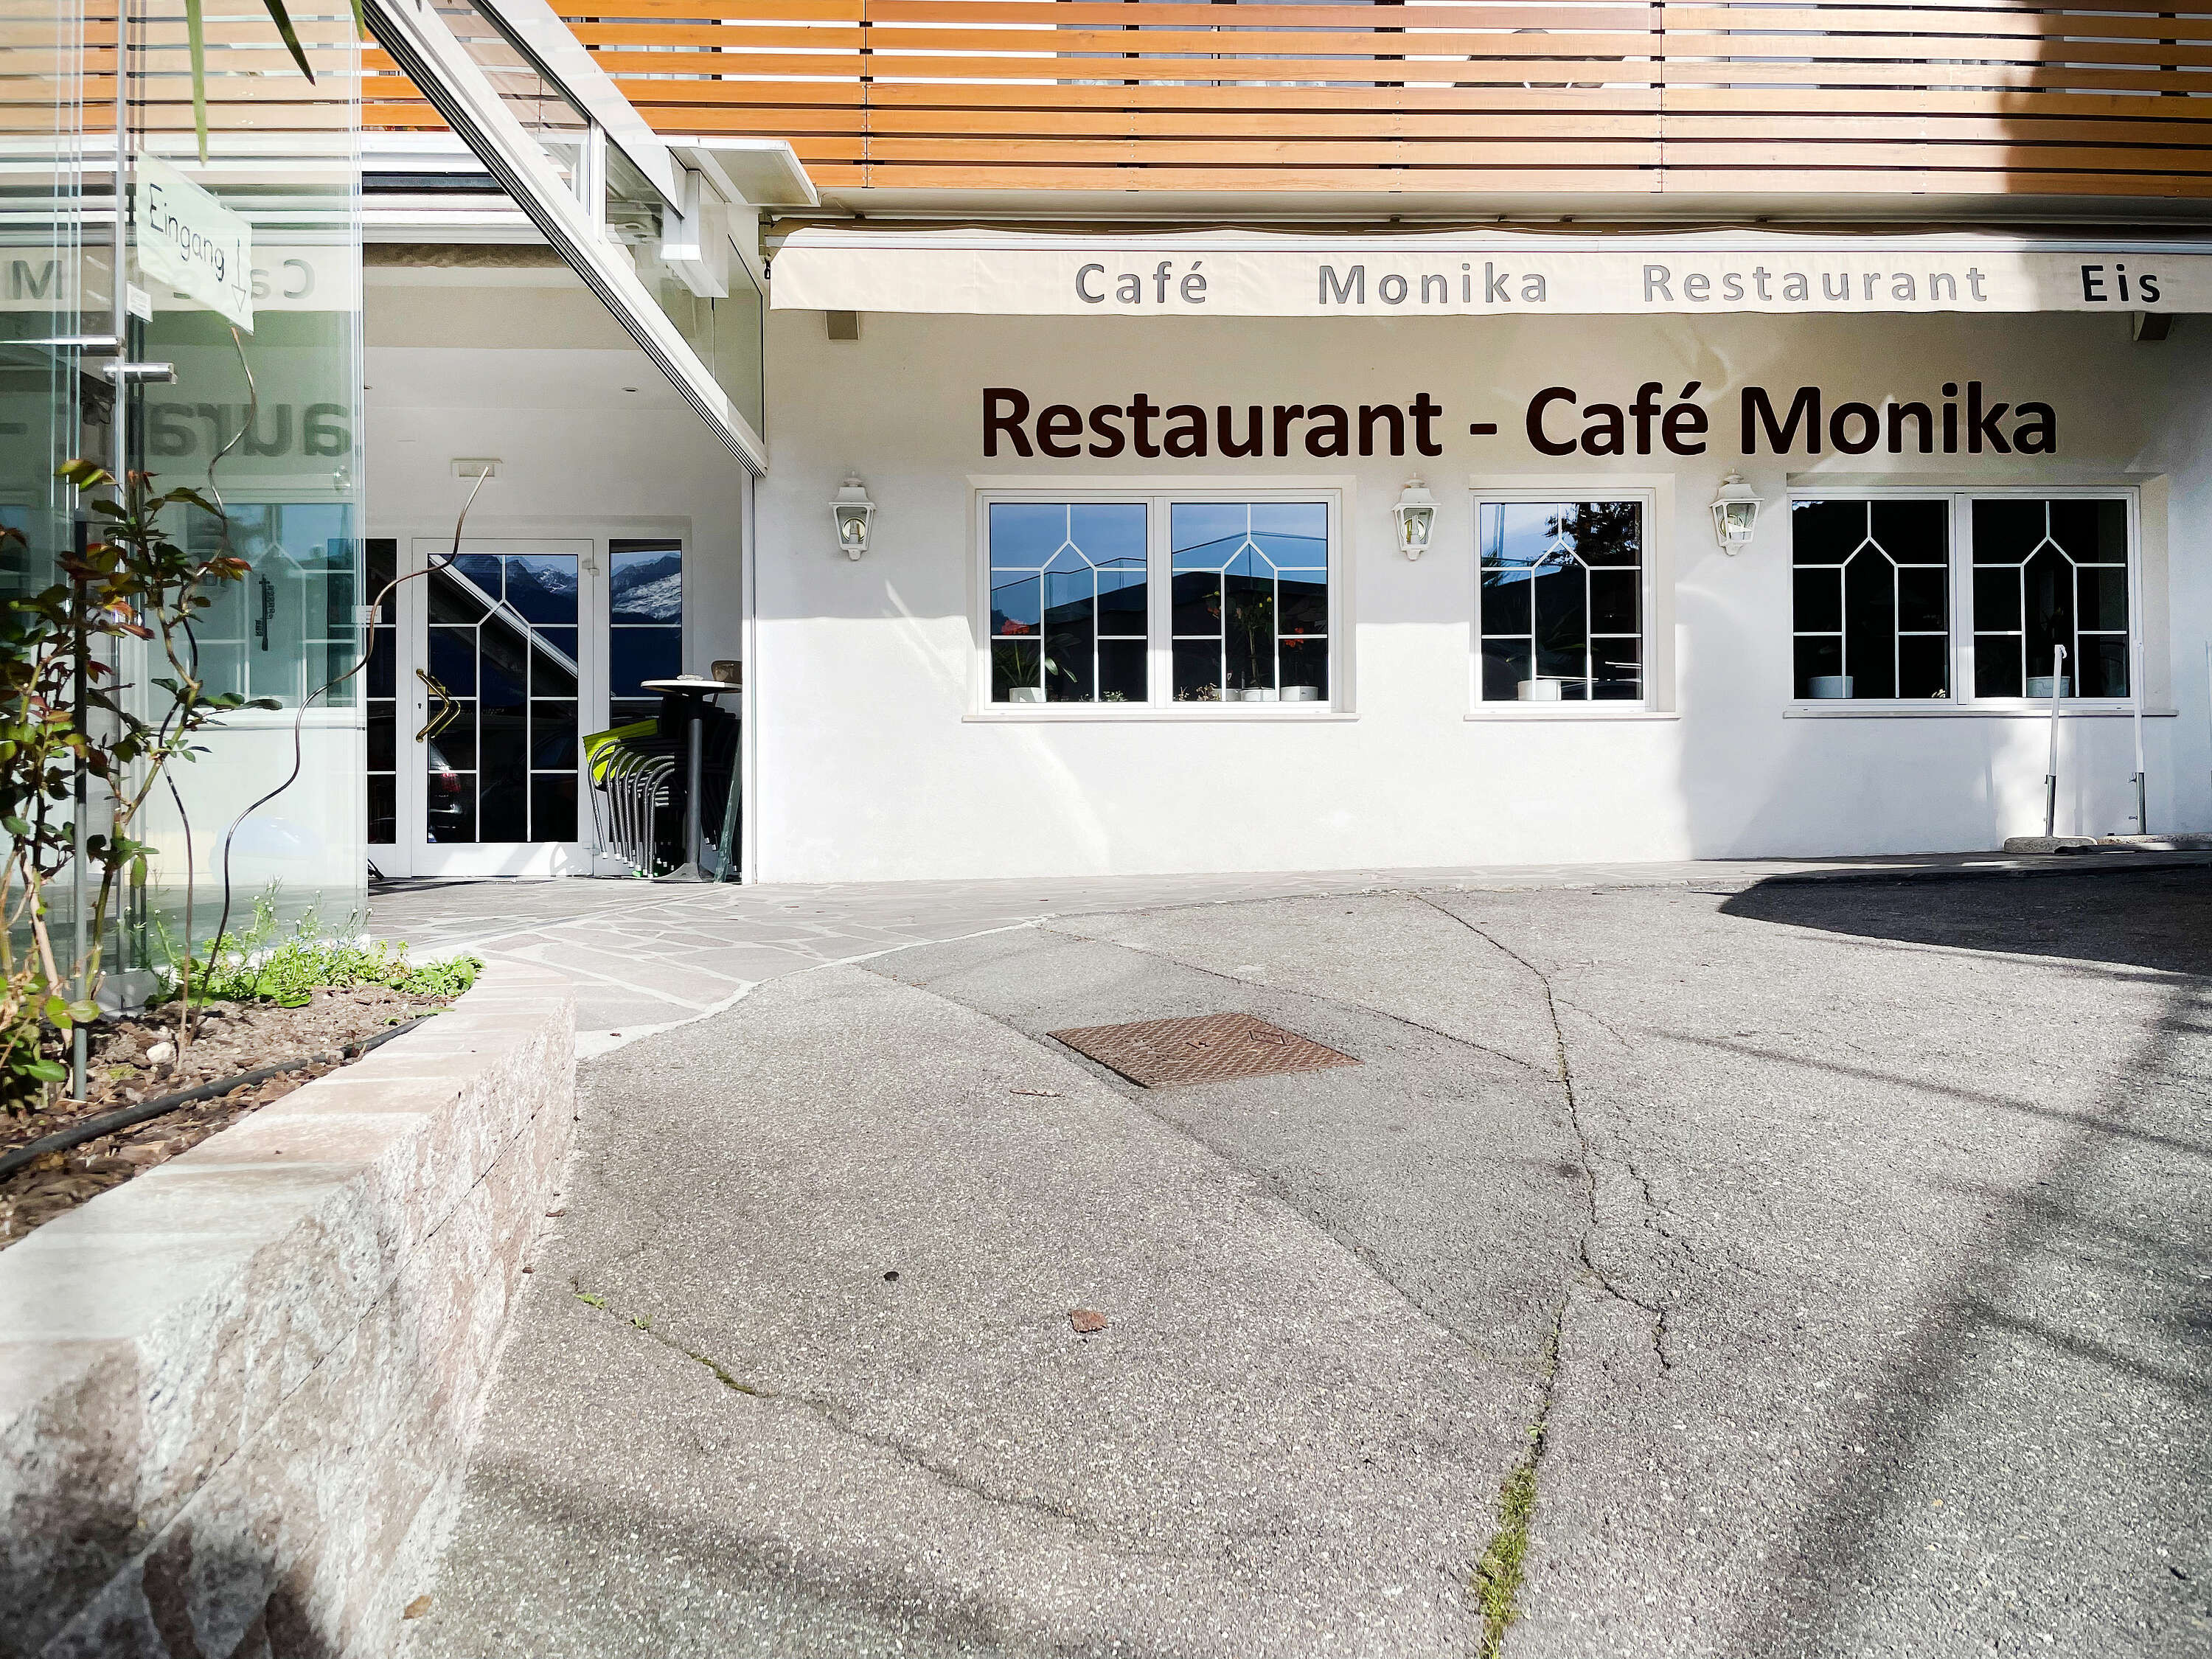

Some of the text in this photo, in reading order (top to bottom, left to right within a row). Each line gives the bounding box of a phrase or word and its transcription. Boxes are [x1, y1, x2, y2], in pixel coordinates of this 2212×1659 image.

[150, 183, 224, 282] Eingang
[1075, 260, 2160, 305] Café Monika Restaurant Eis
[982, 387, 1443, 459] Restaurant
[1525, 380, 1709, 456] Café
[1740, 380, 2057, 456] Monika
